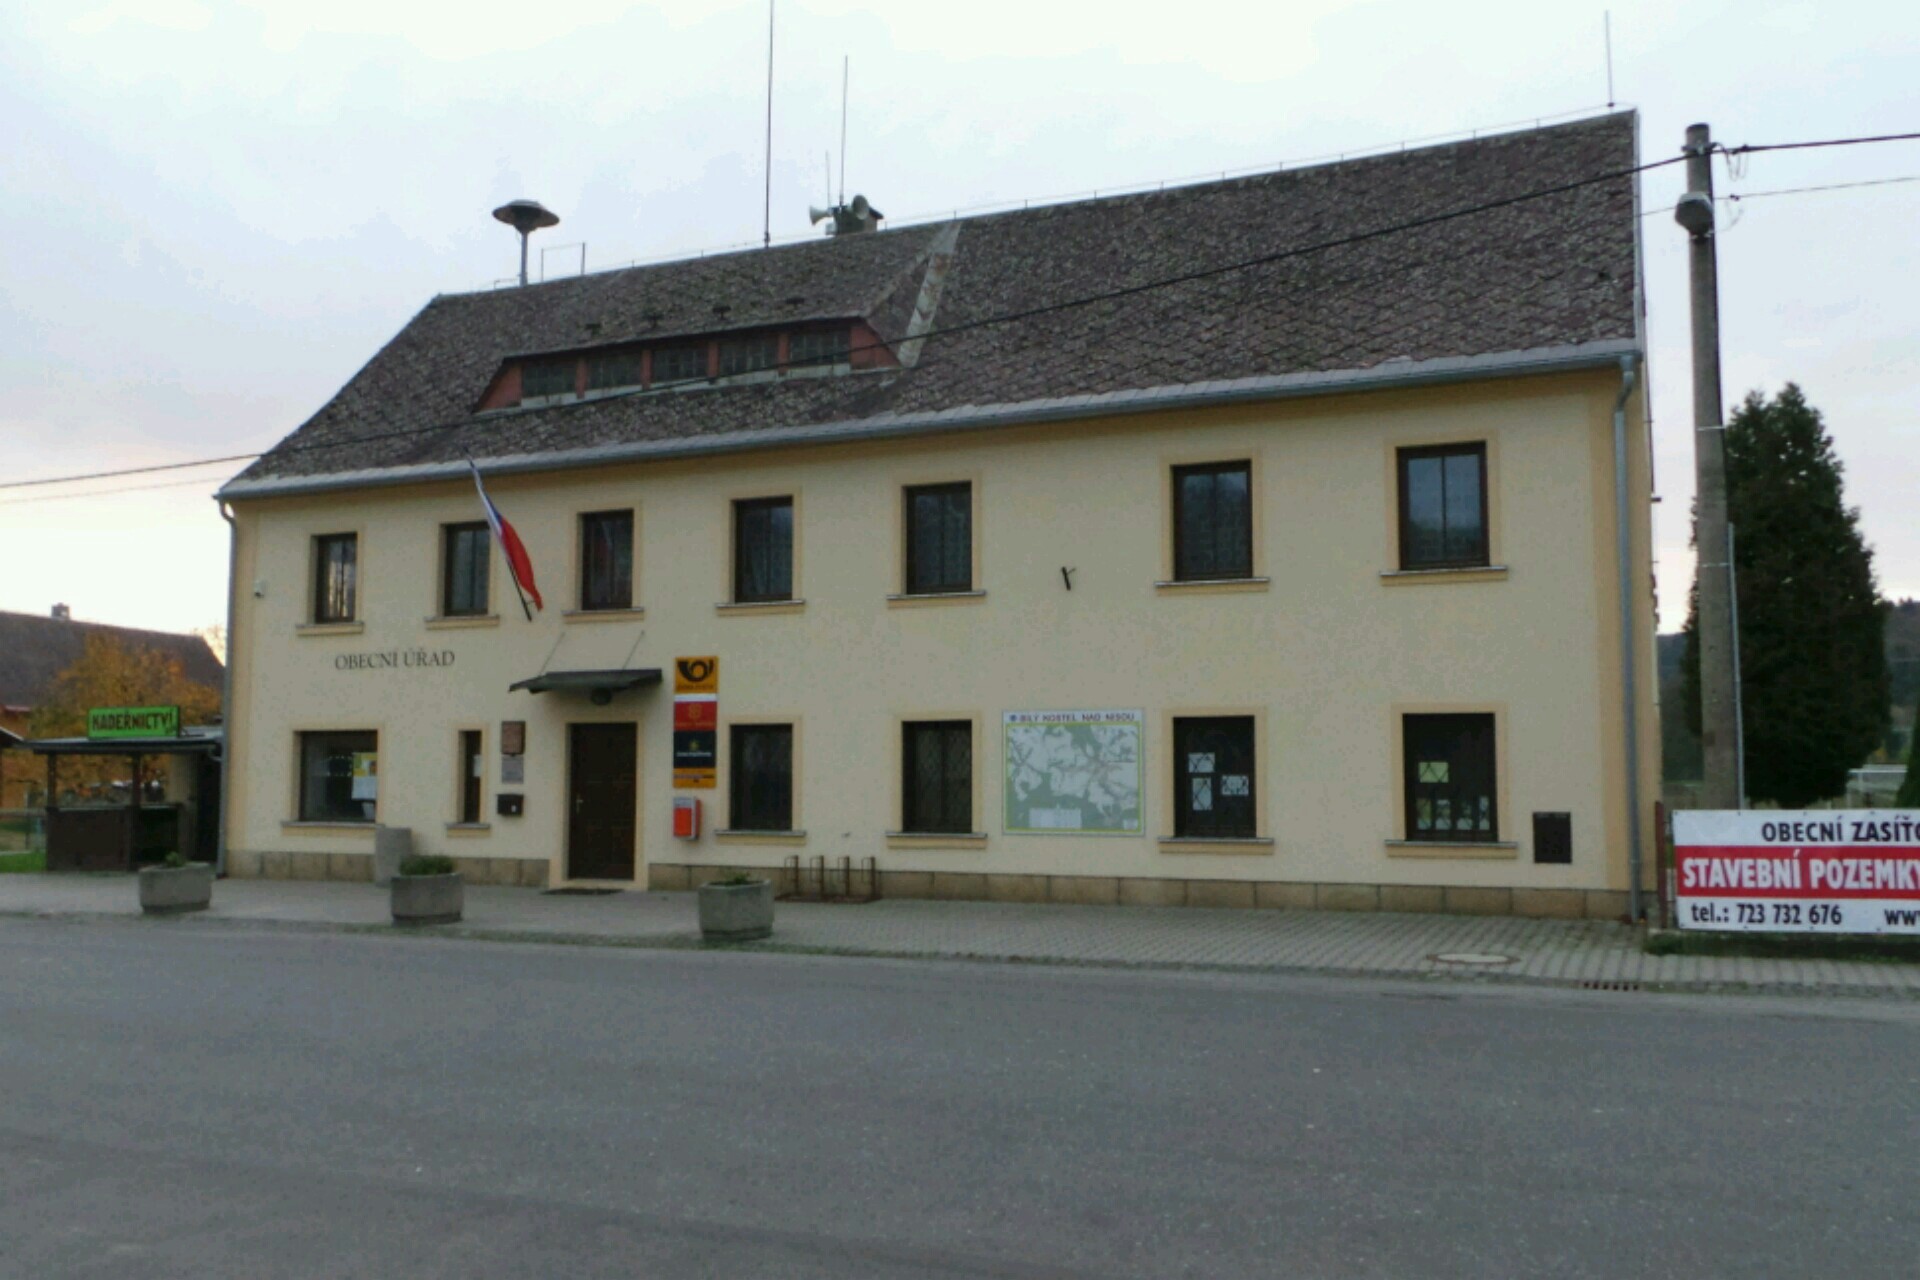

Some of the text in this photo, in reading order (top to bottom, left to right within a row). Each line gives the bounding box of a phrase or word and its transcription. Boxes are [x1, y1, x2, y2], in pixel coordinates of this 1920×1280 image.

[1761, 815, 1843, 842] OBECNÍ
[1682, 848, 1801, 889] STAVEBNÍ
[1690, 902, 1729, 922] tel.:
[1736, 903, 1766, 924] 723
[1772, 903, 1801, 925] 732
[1808, 903, 1843, 925] 676
